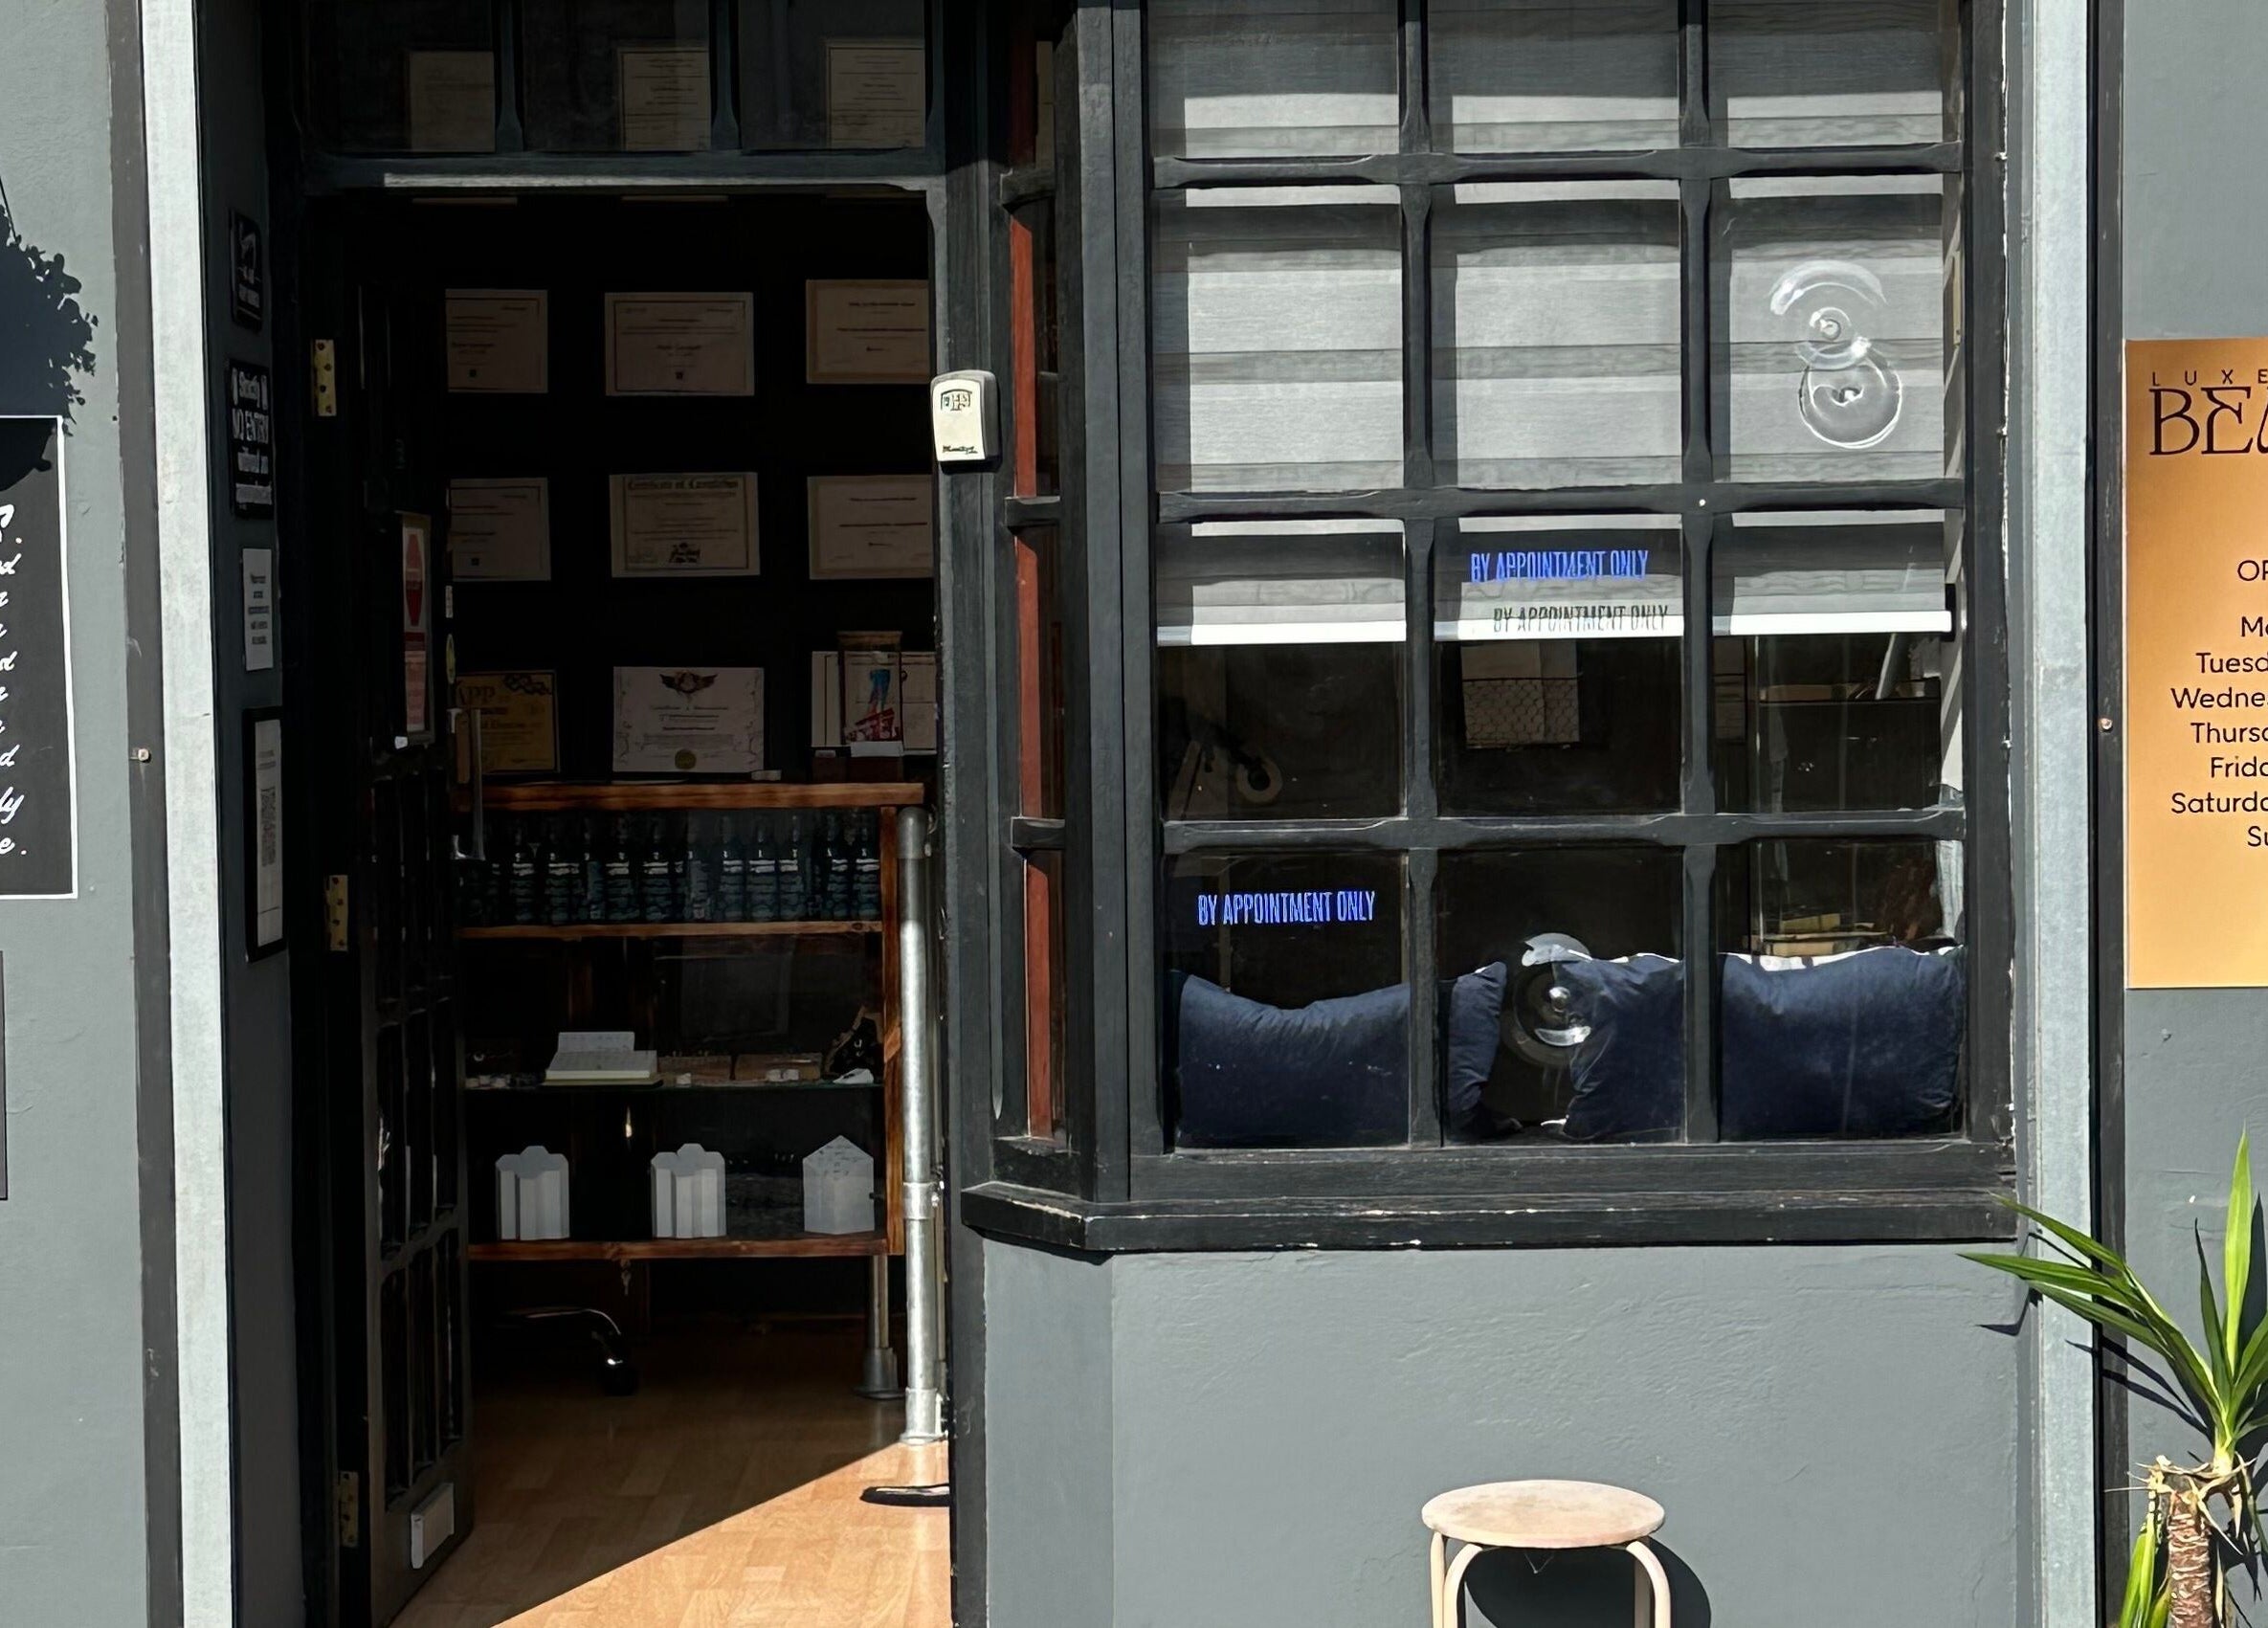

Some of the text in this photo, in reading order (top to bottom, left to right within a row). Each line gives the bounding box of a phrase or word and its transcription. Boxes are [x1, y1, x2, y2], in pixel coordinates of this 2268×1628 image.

[1471, 549, 1649, 583] BY APPOINTMENT ONLY
[2170, 686, 2268, 709] Wedne
[1198, 890, 1376, 926] BY APPOINTMENT ONLY
